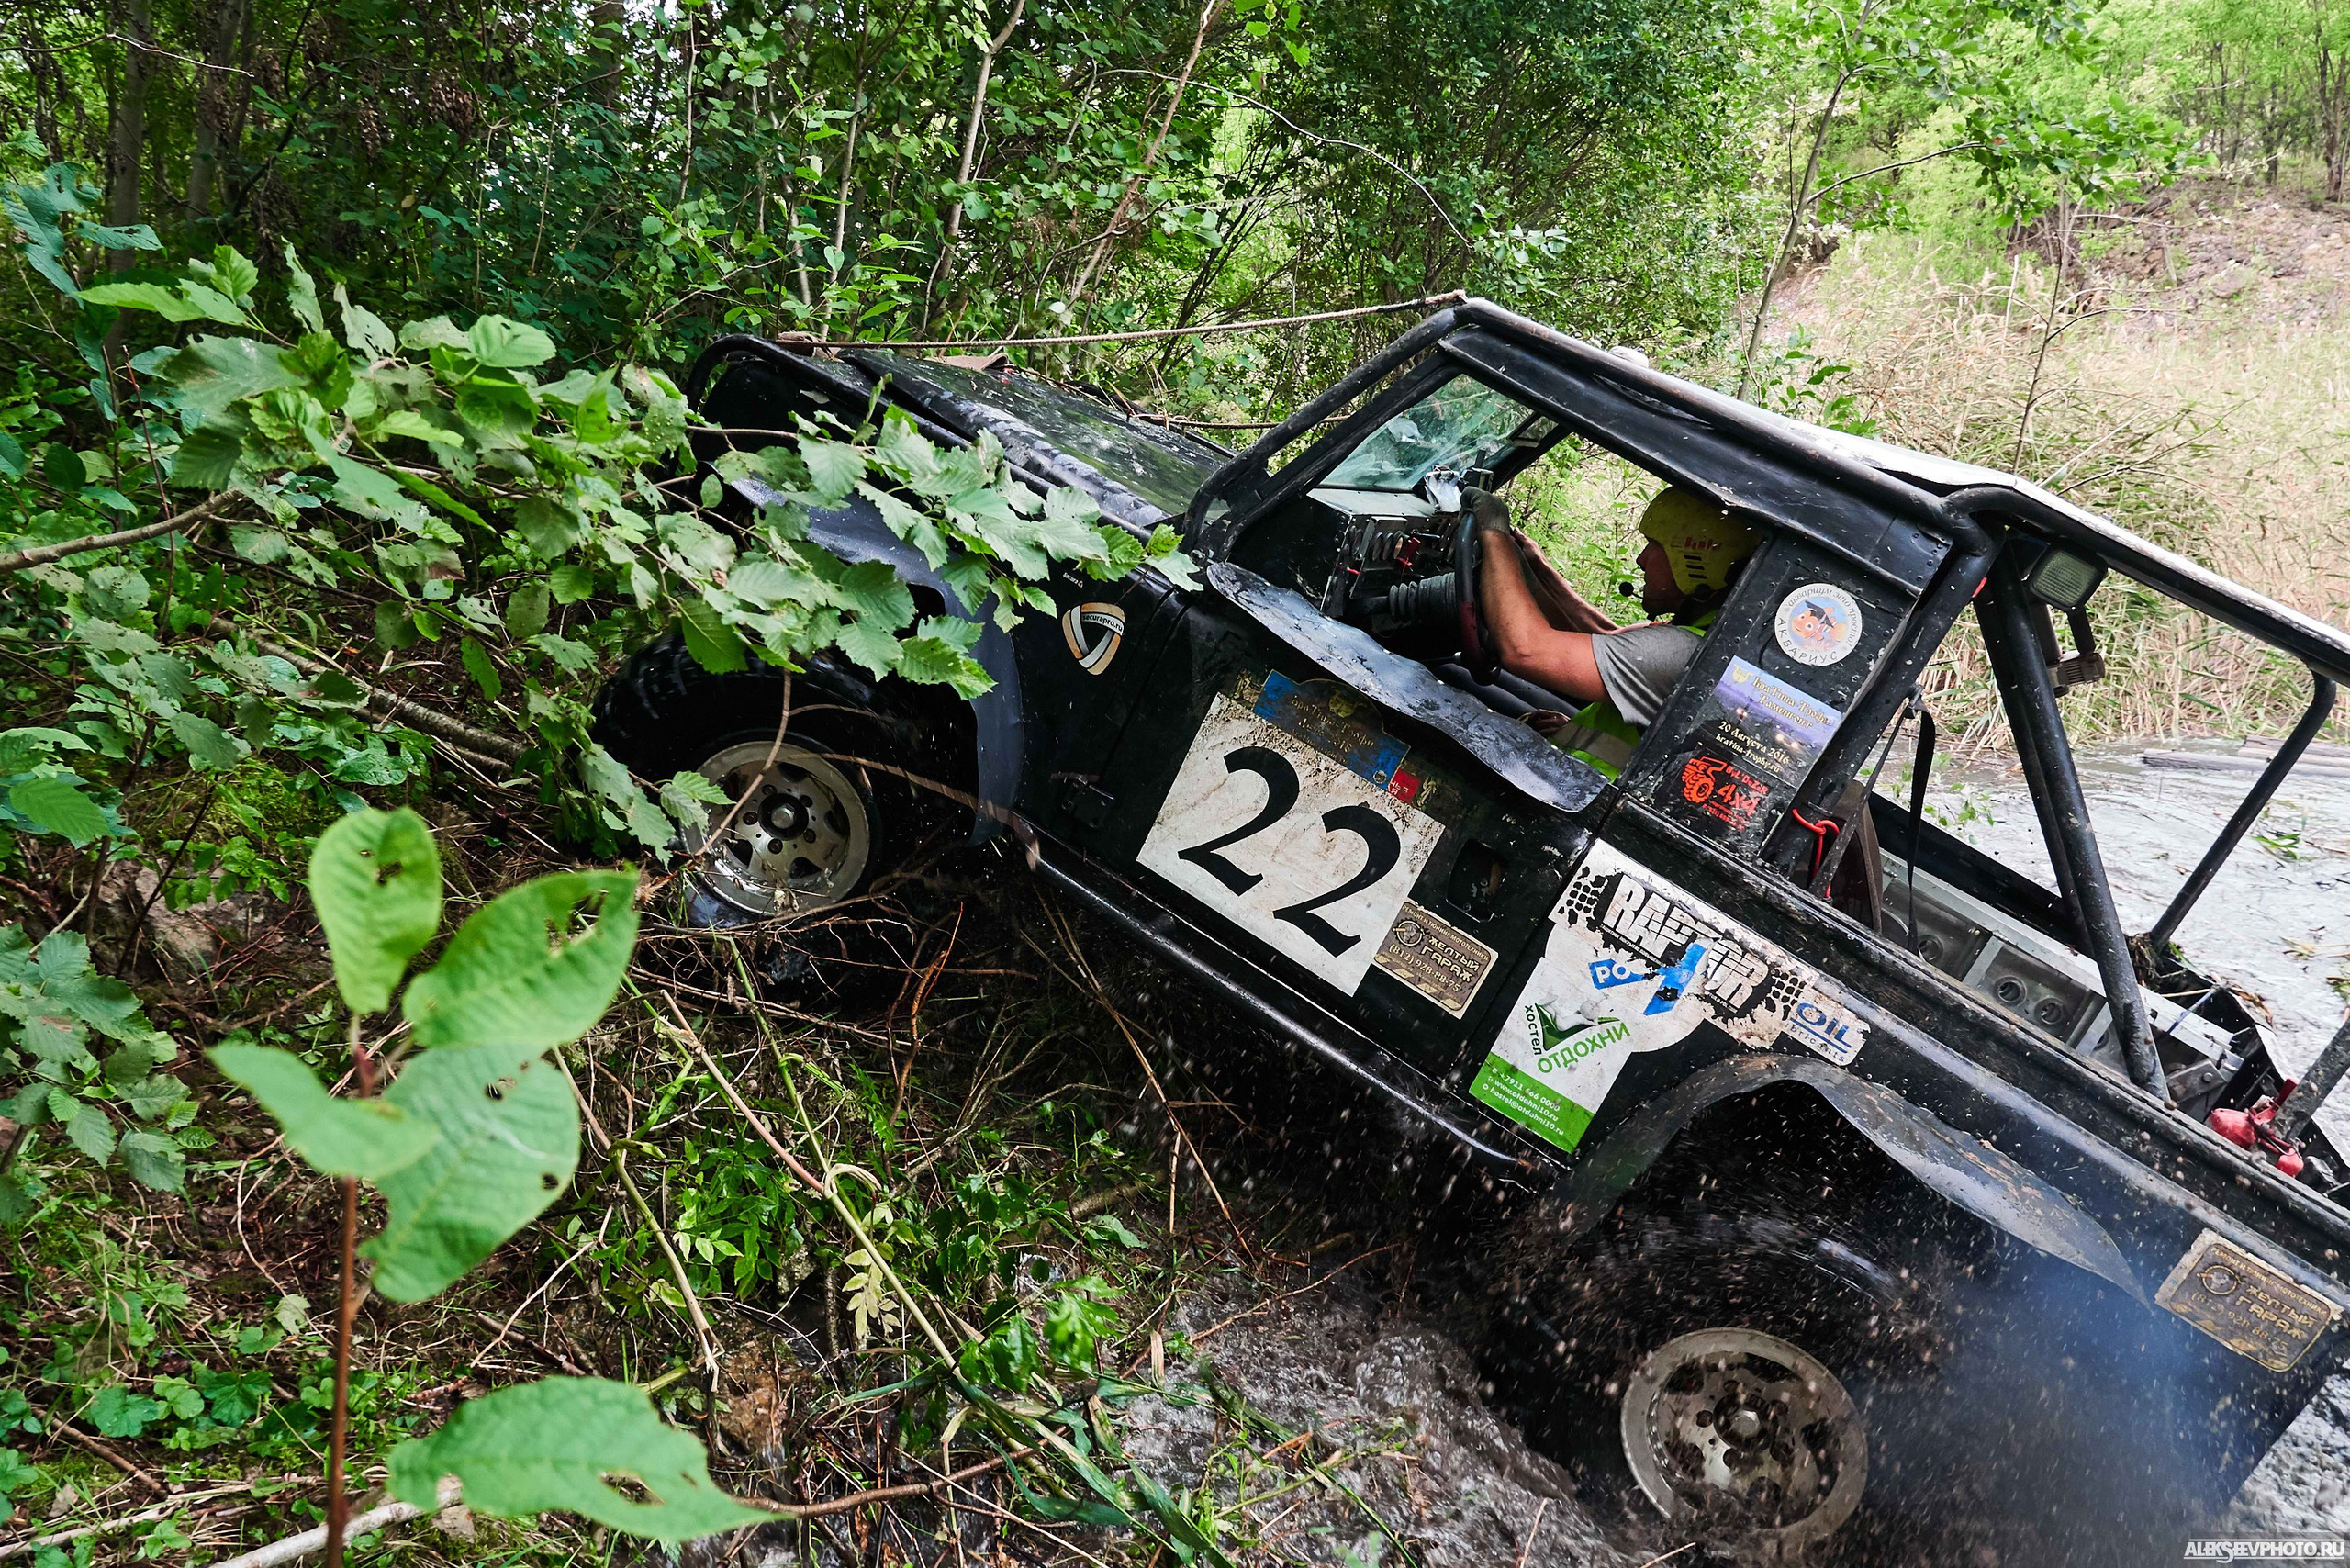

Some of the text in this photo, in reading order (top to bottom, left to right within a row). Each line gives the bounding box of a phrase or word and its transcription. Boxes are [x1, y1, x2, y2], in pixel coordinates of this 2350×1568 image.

[1788, 588, 1832, 607] аквариум
[1833, 591, 1851, 607] это
[1082, 614, 1123, 633] securapro.ru
[1777, 617, 1838, 664] АКВАРИУС
[1716, 734, 1784, 772] bratina-trophy.ru
[1718, 721, 1790, 765] 20 Августа 2016
[1178, 745, 1401, 958] 22
[1403, 905, 1424, 921] РЕМОНТ
[1427, 921, 1450, 937] ТЮНИНГ
[1450, 935, 1489, 961] МОТОТЕХНИКИ
[1428, 936, 1481, 971] ЖЕЛТЫЙ
[1389, 944, 1415, 964] (812)
[1416, 959, 1460, 991] 928-88-75
[1421, 946, 1472, 982] ГАРАЖ
[1537, 1022, 1631, 1073] ОТДОХНИ
[1490, 1084, 1564, 1136] hostel@otdohni10.ru
[1494, 1080, 1559, 1122] www.otdohni10.ru
[1500, 1072, 1560, 1112] +7911 666 0000
[2235, 1295, 2307, 1340] ГАРАЖ
[2246, 1284, 2318, 1328] ЖЕЛТЫЙ
